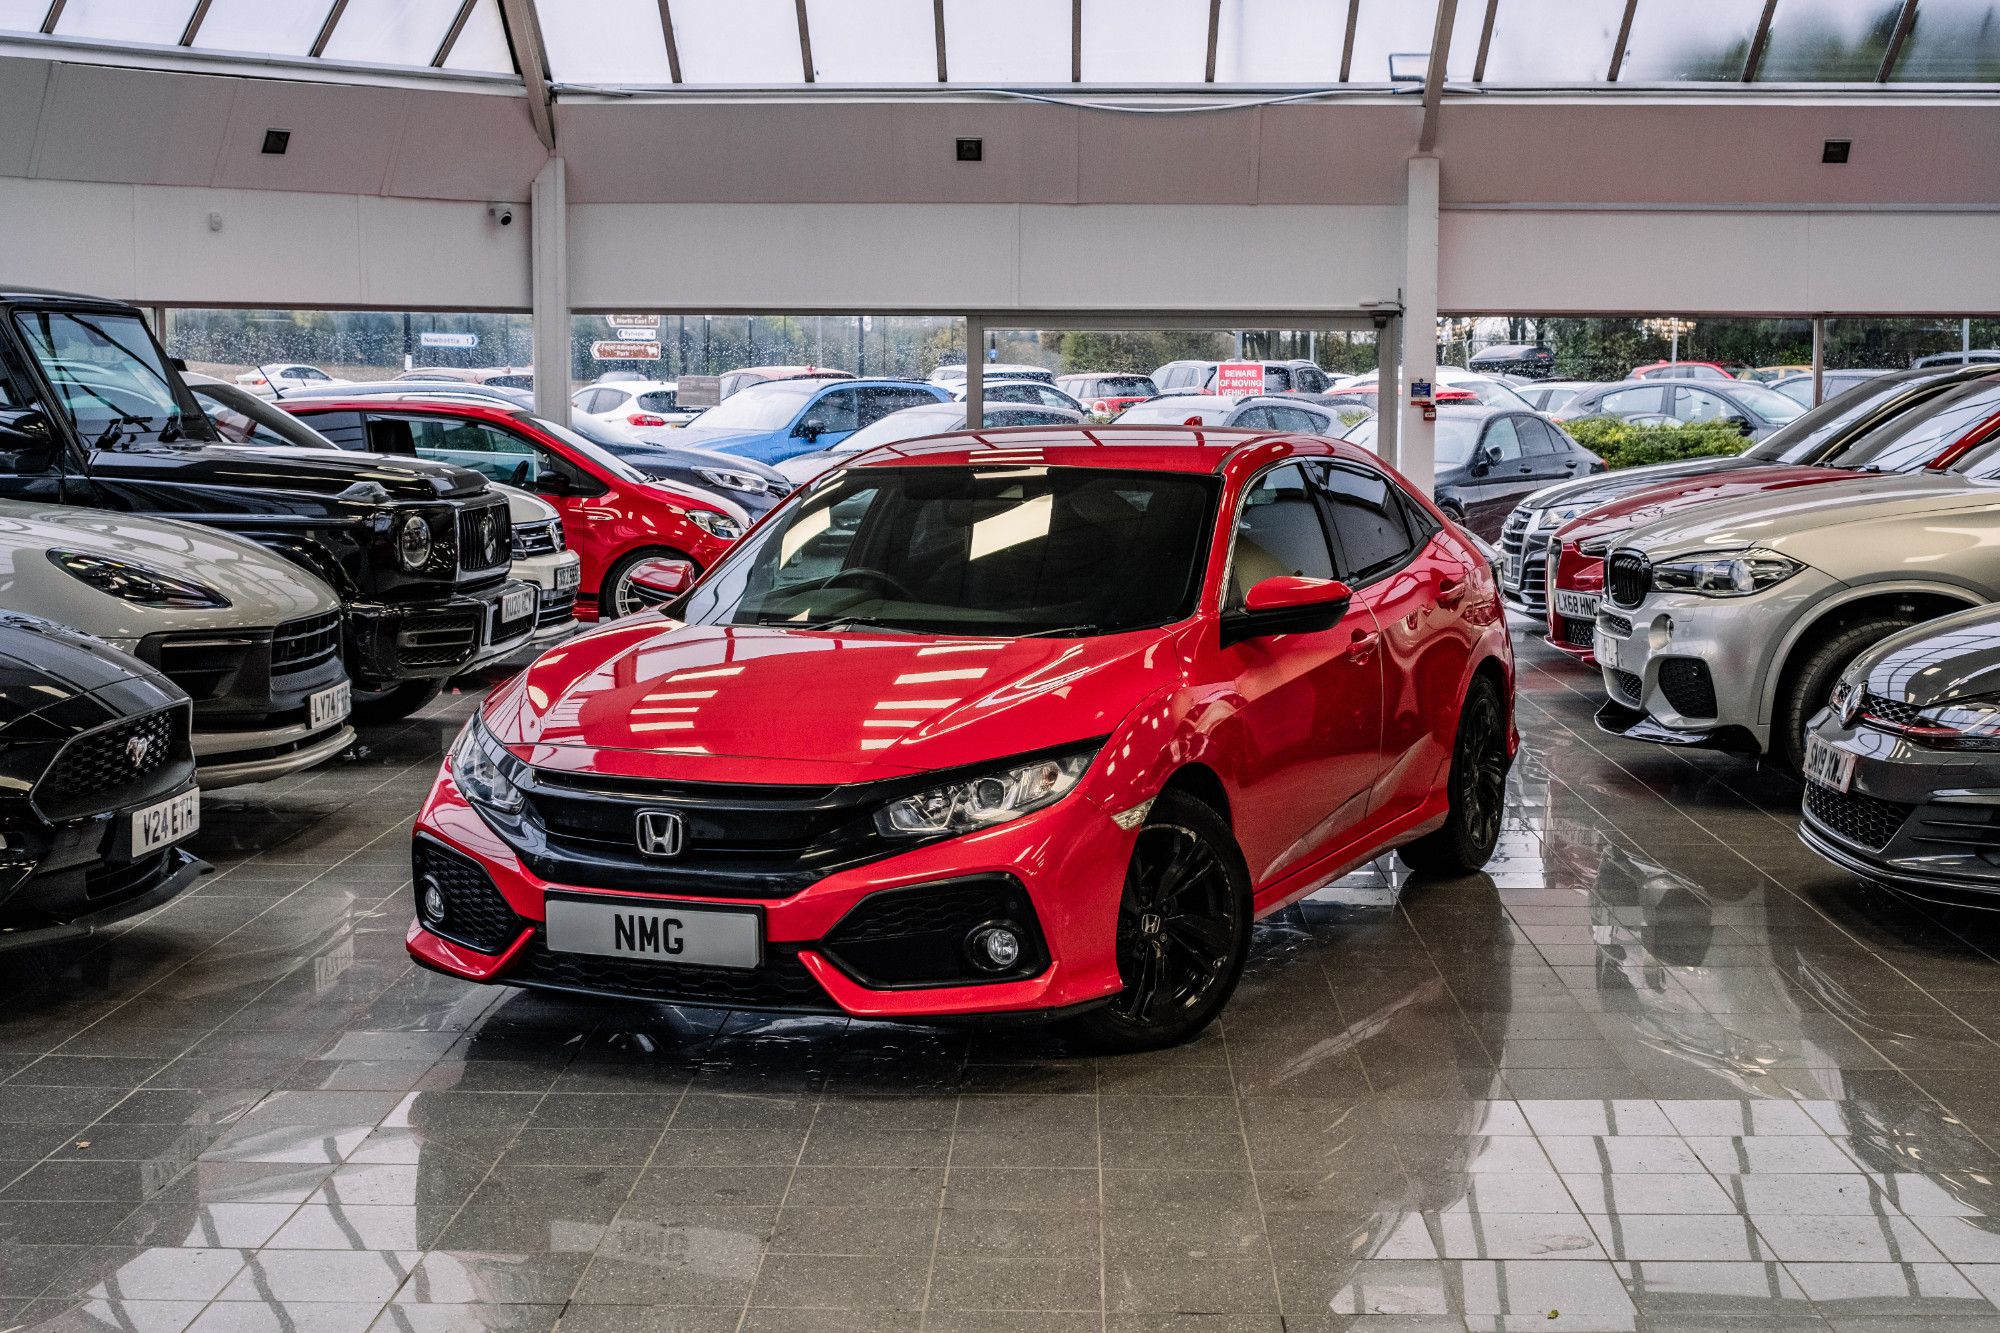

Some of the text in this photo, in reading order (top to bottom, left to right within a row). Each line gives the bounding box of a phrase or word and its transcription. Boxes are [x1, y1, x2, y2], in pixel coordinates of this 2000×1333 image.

[1219, 379, 1263, 387] OF MOVING
[1224, 369, 1258, 377] BEWARE
[1557, 593, 1579, 613] LX68
[315, 691, 335, 722] LY74
[143, 807, 169, 846] V24
[614, 914, 684, 955] NMG
